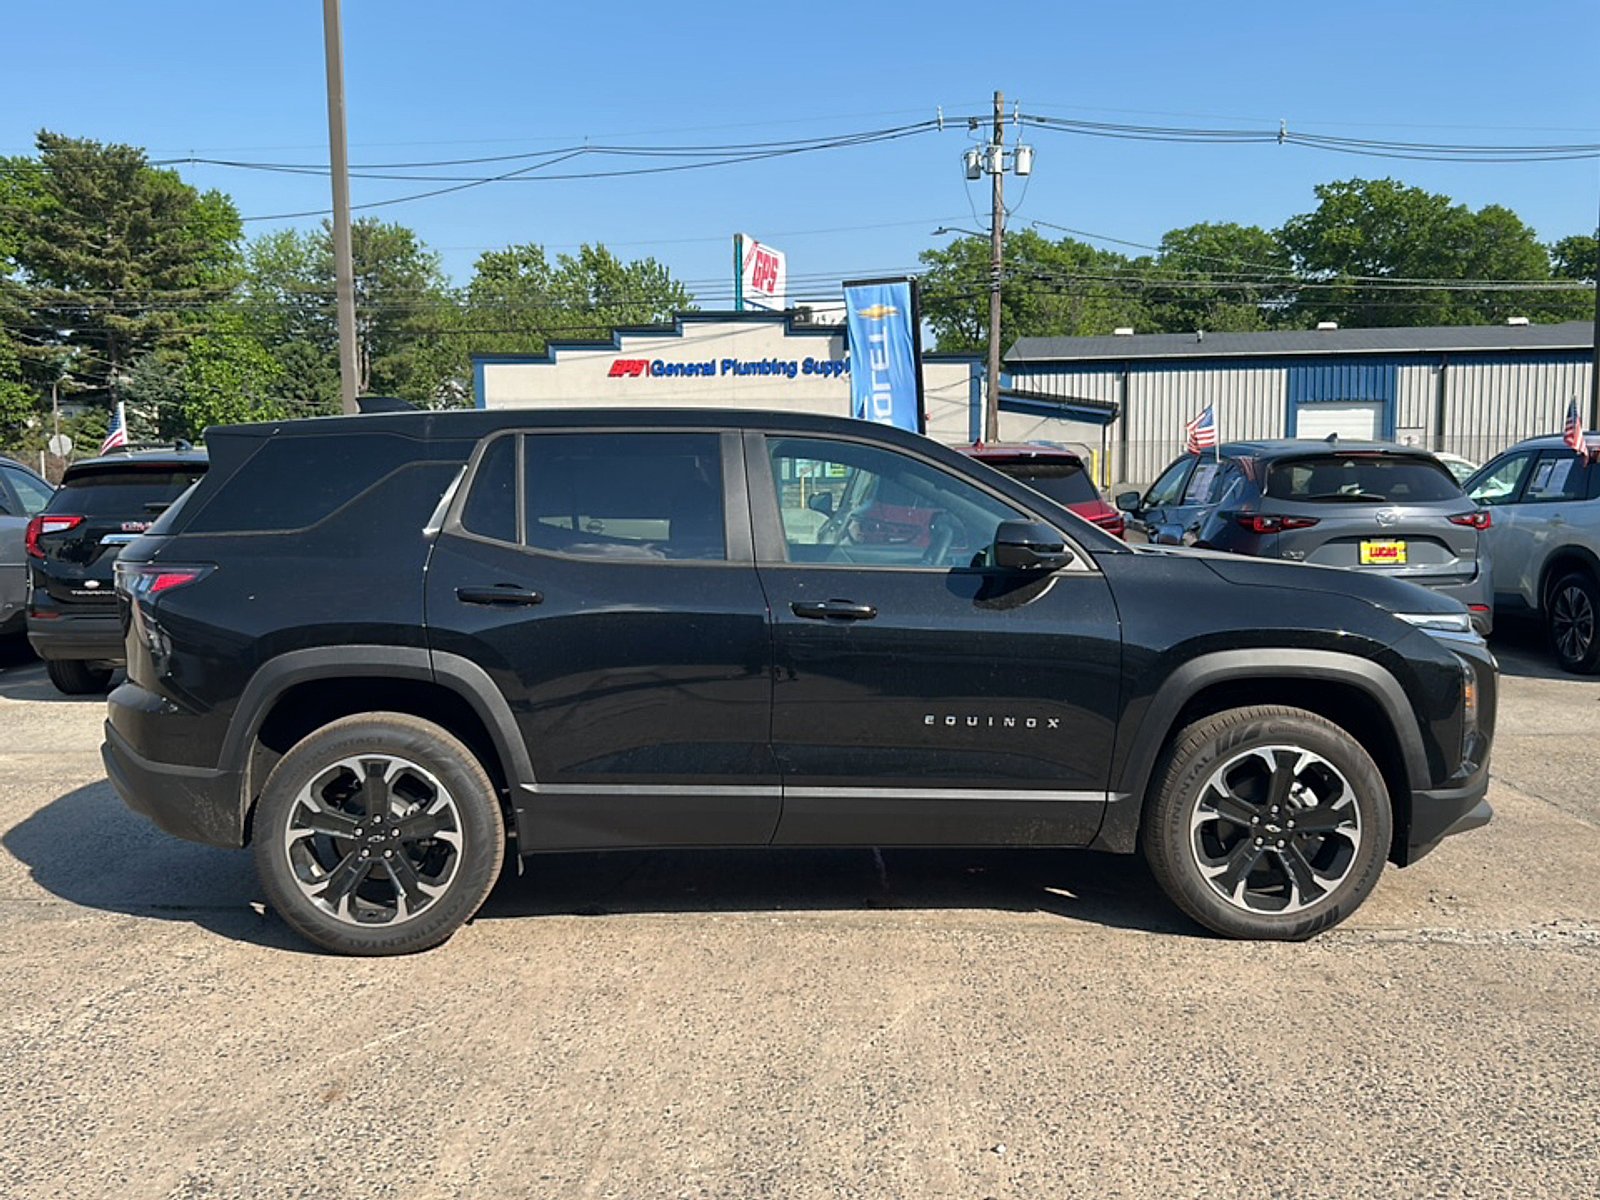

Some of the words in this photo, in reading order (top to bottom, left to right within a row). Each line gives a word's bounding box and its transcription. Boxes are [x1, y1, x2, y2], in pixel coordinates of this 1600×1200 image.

[752, 249, 779, 294] GPS
[651, 359, 716, 377] General
[720, 357, 798, 379] Plumbing
[801, 356, 851, 379] Suppl
[924, 714, 1060, 728] EQUINOX
